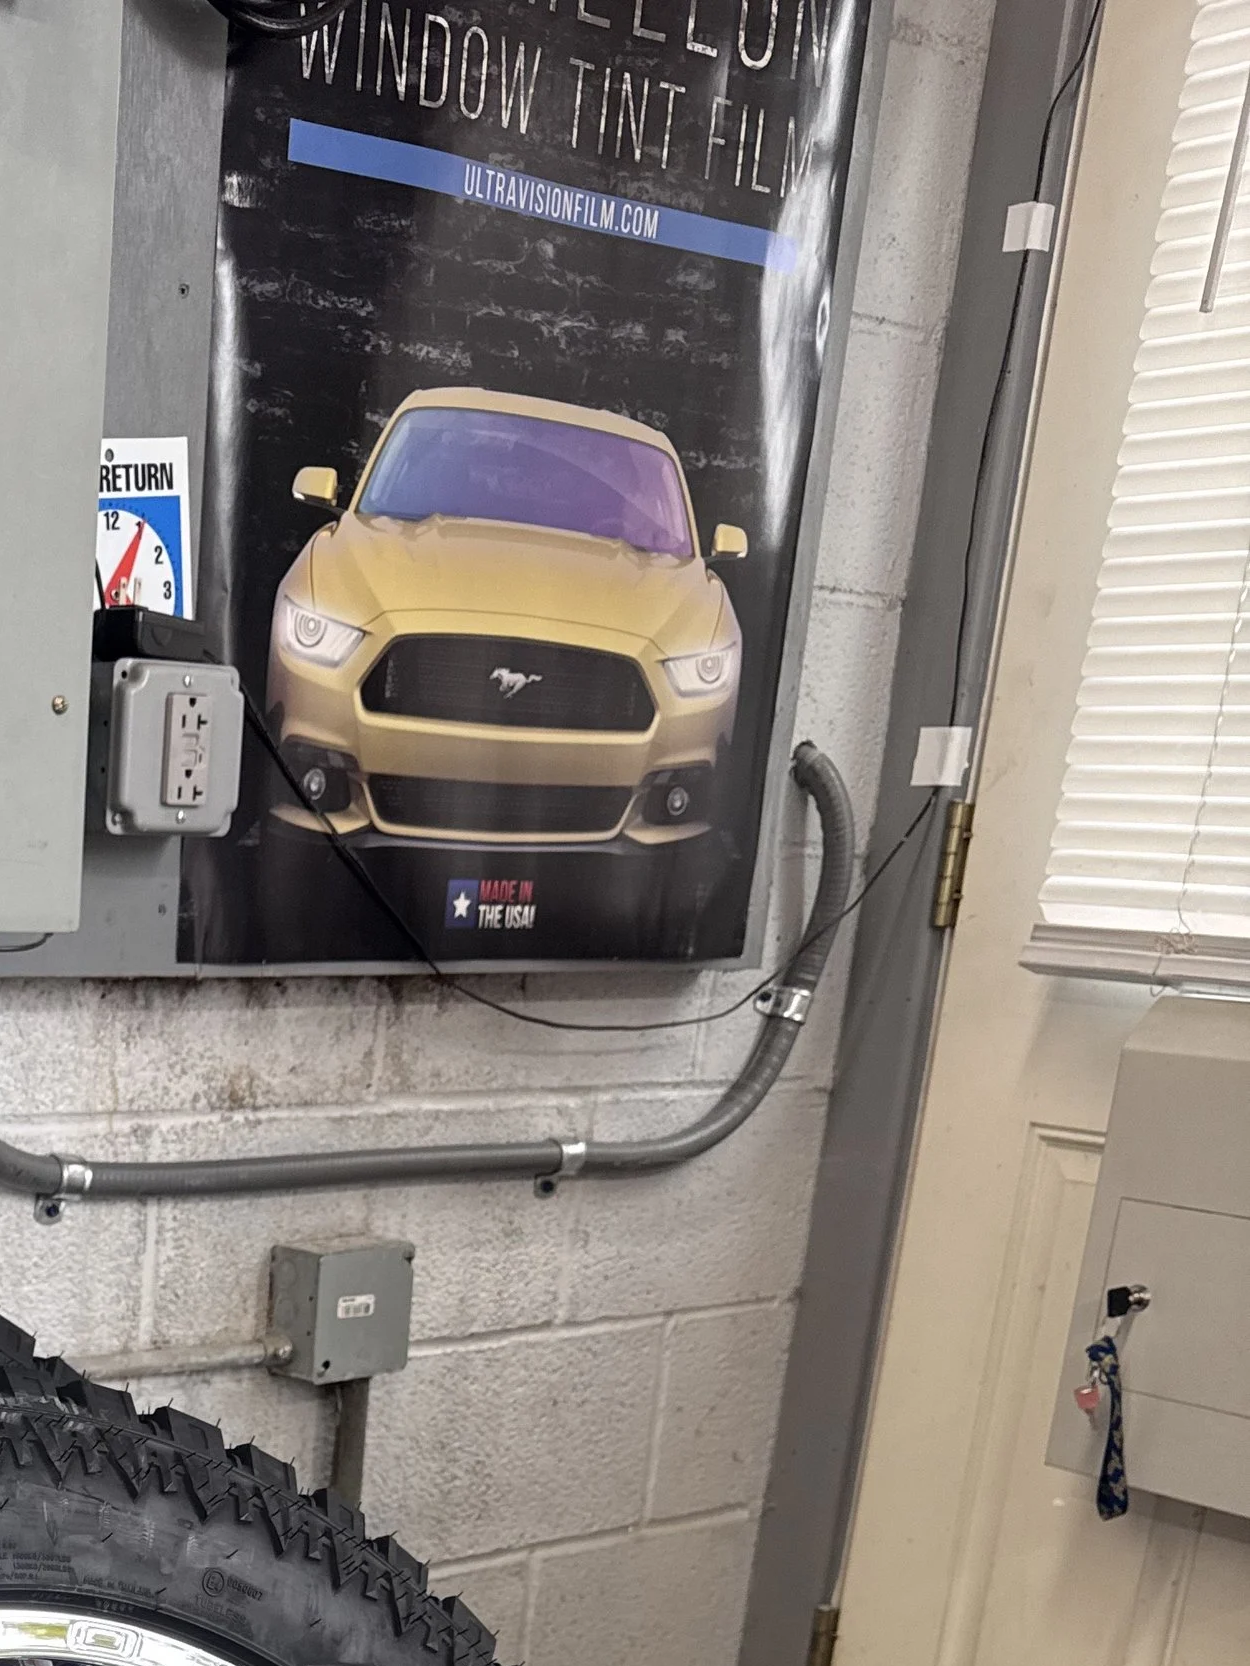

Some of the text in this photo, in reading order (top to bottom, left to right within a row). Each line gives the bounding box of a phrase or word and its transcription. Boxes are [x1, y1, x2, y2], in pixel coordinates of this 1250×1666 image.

[301, 0, 543, 135] WINDOW
[569, 57, 687, 170] TINT
[704, 95, 817, 200] FILM
[464, 163, 660, 240] ULTRAVISIONFILM.COM
[100, 462, 174, 493] RETURN
[104, 511, 120, 531] 12
[154, 546, 164, 564] 2
[163, 581, 172, 599] 3
[480, 879, 535, 904] MADE IN
[478, 904, 537, 929] THE USA!
